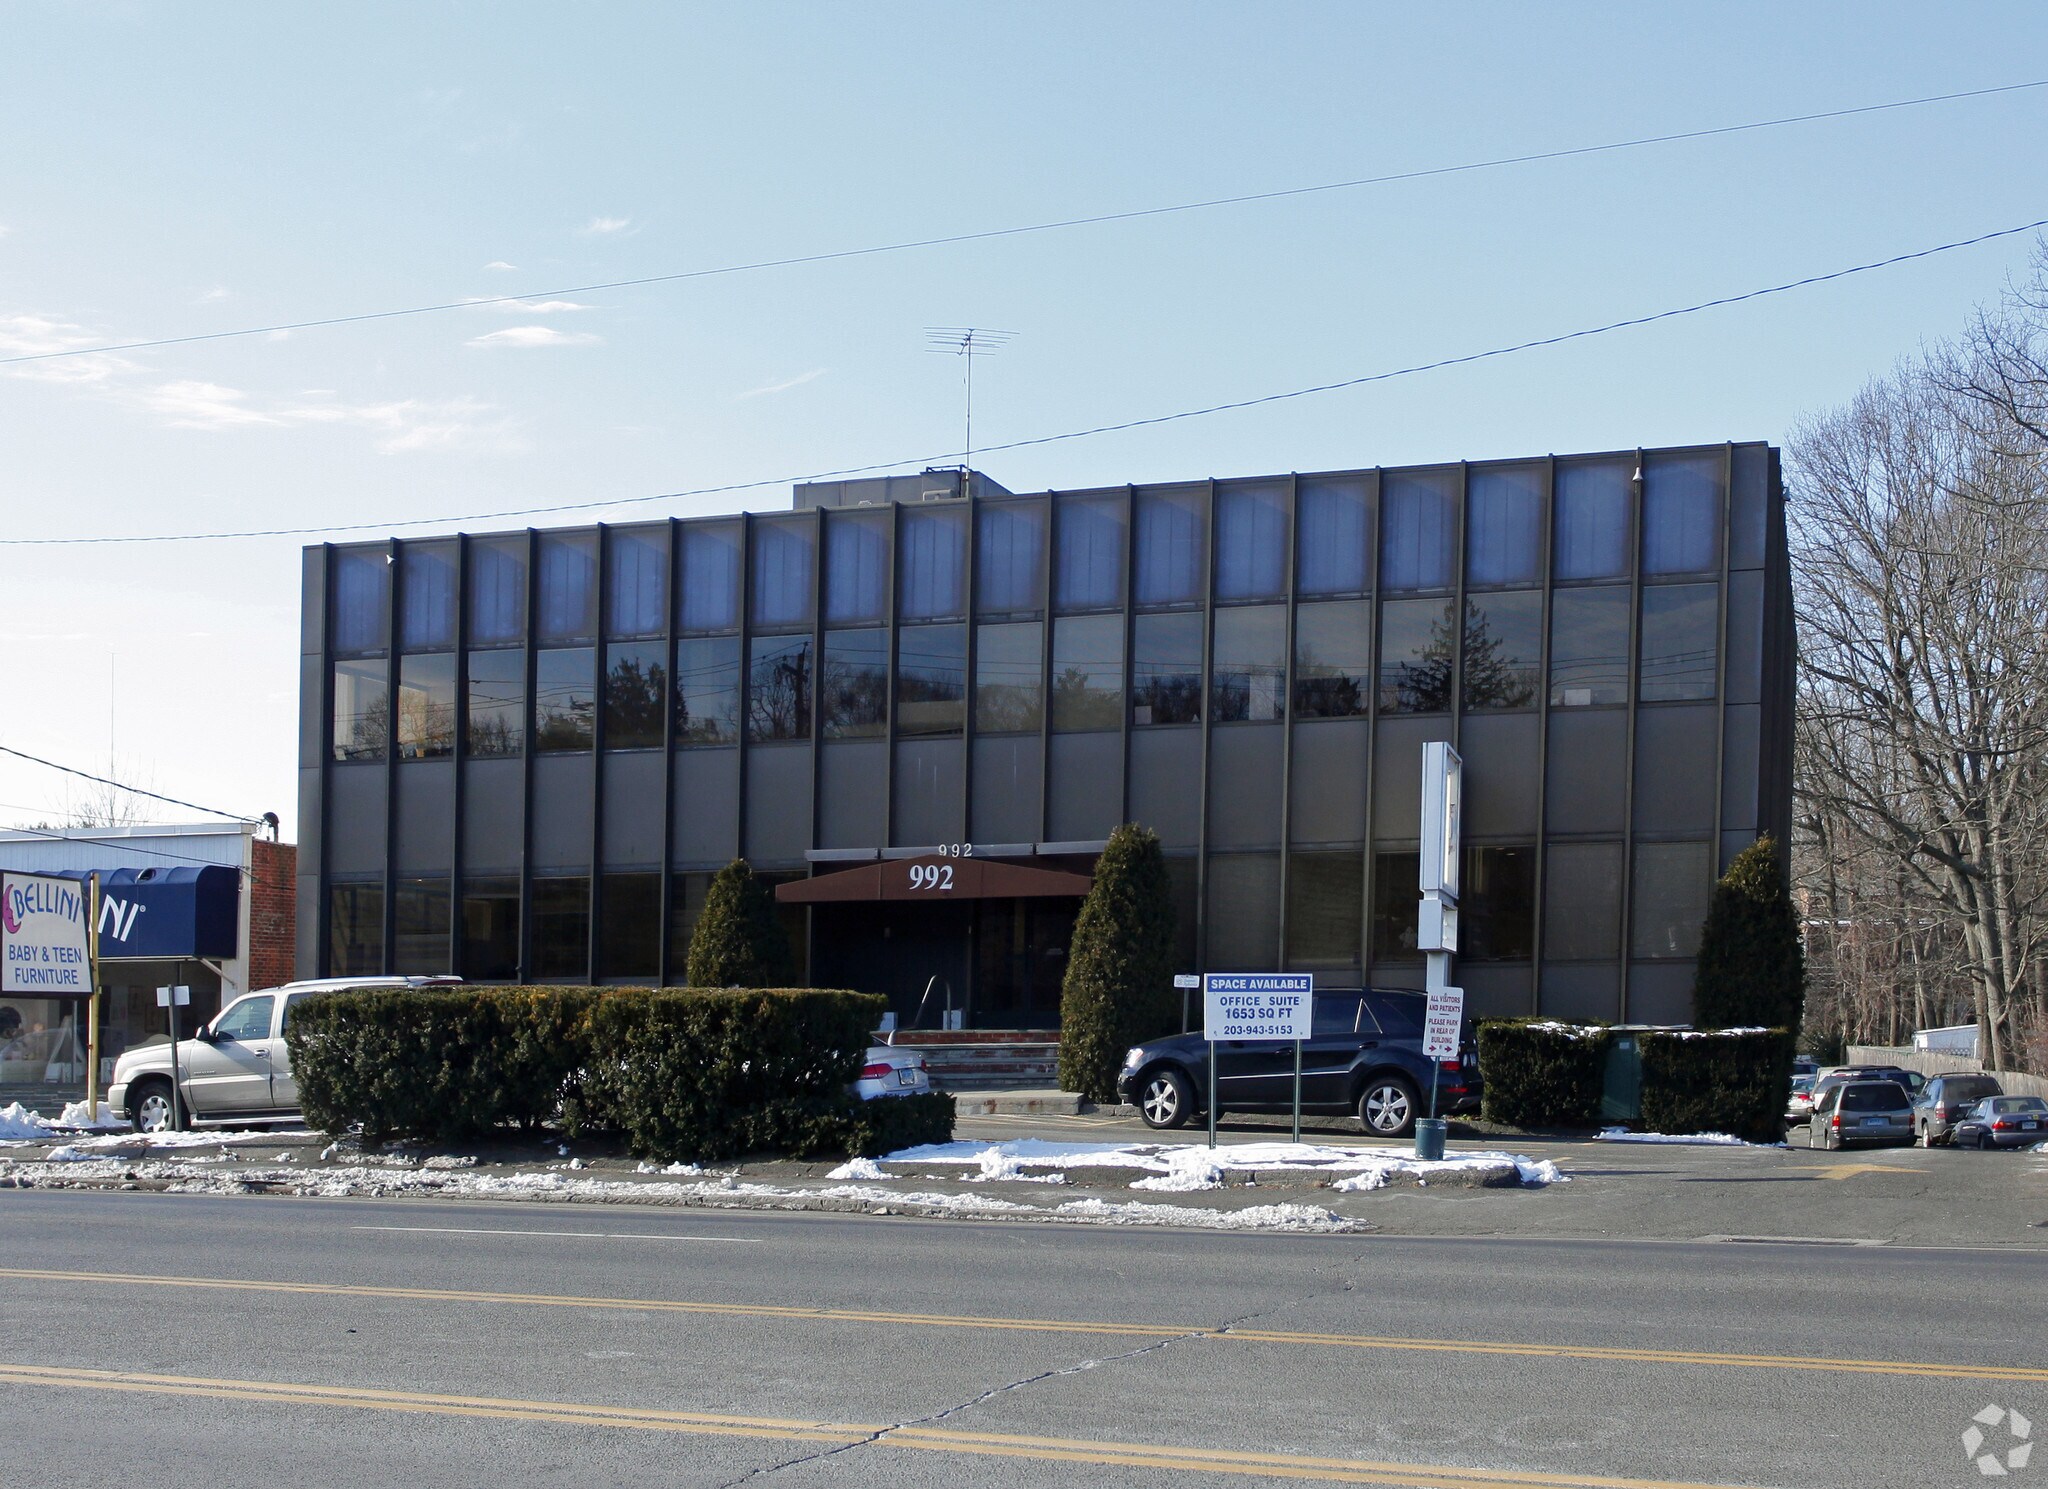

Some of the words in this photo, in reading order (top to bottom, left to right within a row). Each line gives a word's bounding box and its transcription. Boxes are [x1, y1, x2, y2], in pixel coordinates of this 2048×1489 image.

[938, 843, 972, 857] 992
[909, 865, 953, 889] 992
[13, 883, 80, 923] BELLINI
[97, 894, 139, 942] NI
[9, 944, 38, 961] BABY
[41, 946, 50, 962] &
[52, 947, 82, 963] TEEN
[14, 967, 79, 985] FURNITURE
[1211, 979, 1247, 990] SPACE
[1249, 979, 1308, 990] AVAILABLE
[1220, 996, 1260, 1006] OFFICE
[1269, 996, 1300, 1006] SUITE
[1225, 1008, 1255, 1019] 1653
[1258, 1008, 1275, 1019] SQ
[1278, 1008, 1293, 1018] FT
